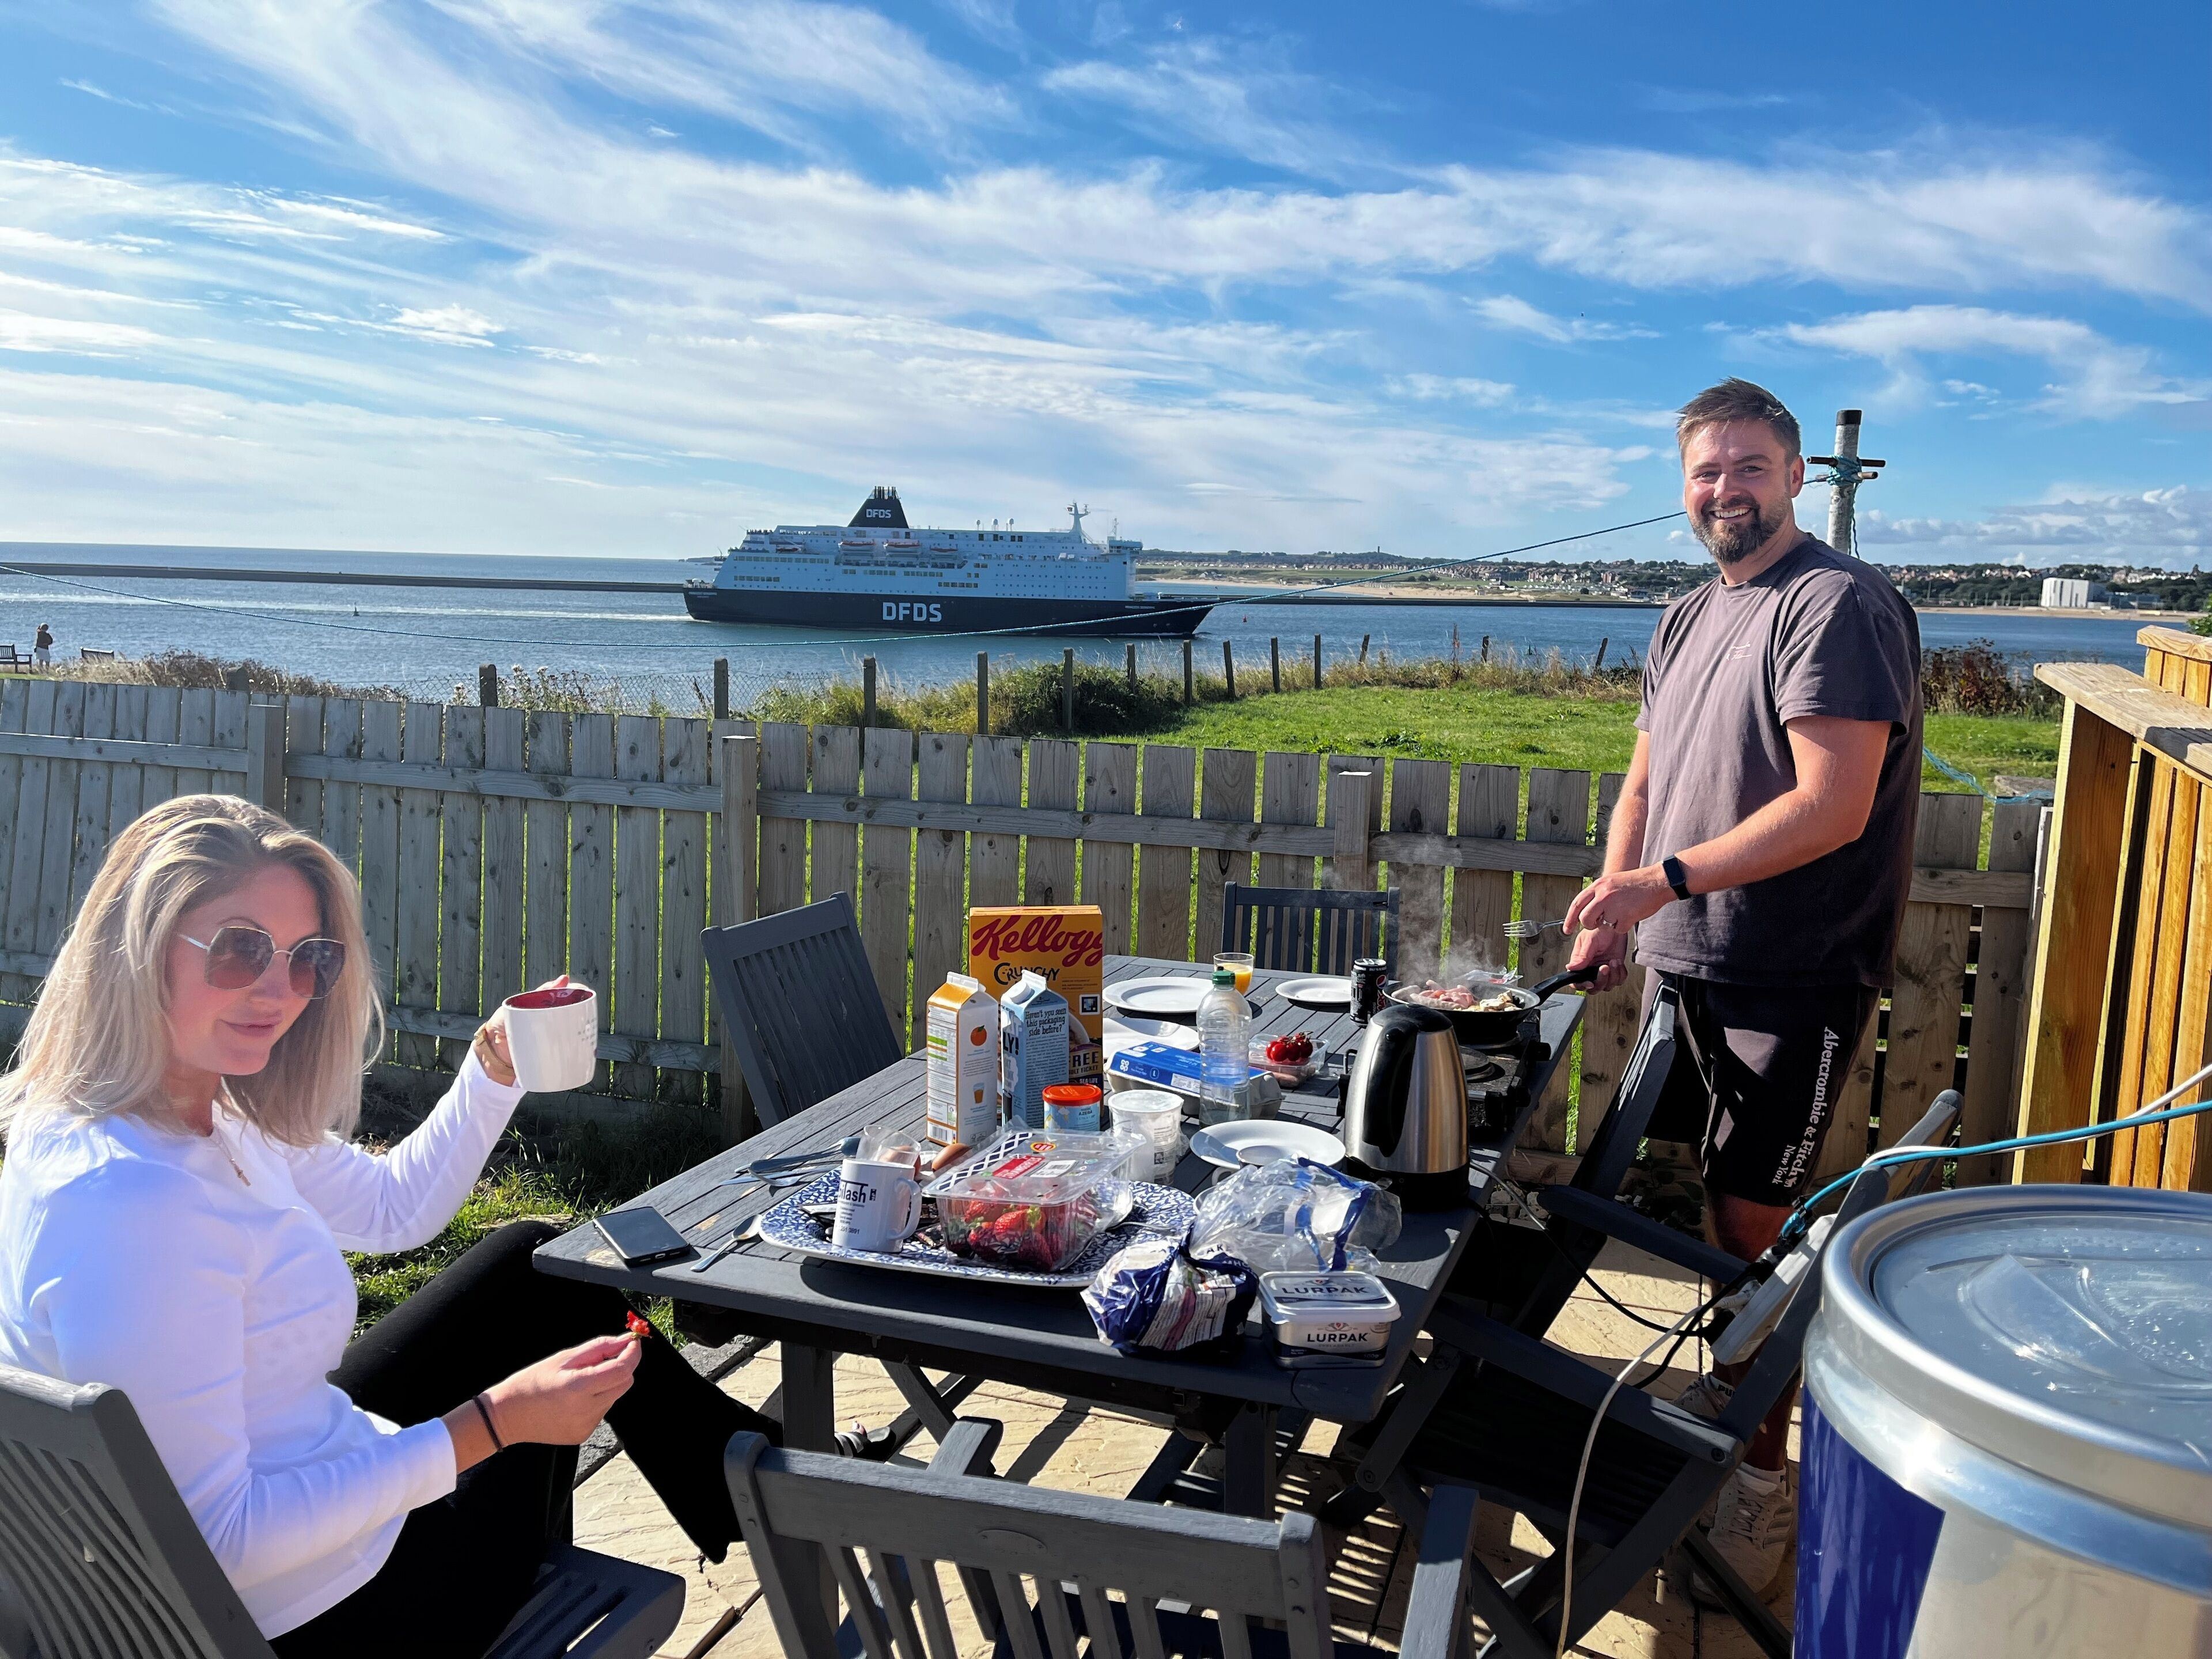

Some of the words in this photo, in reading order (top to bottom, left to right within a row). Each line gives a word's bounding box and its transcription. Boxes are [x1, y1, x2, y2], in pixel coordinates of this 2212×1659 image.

[866, 509, 892, 518] DFDS
[882, 602, 942, 622] DFDS
[1025, 1009, 1043, 1019] Haven't
[1044, 1010, 1054, 1018] you
[1027, 1018, 1037, 1027] this
[1039, 1017, 1065, 1028] packaging
[1029, 1027, 1040, 1037] side
[1042, 1024, 1062, 1035] before?
[1069, 1051, 1099, 1068] REE
[1809, 1027, 1840, 1124] Abercrombie
[1804, 1126, 1817, 1138] &
[1781, 1144, 1796, 1165] New
[1788, 1139, 1815, 1177] Fitch
[1771, 1166, 1789, 1184] York
[1307, 1332, 1369, 1342] LURPAK
